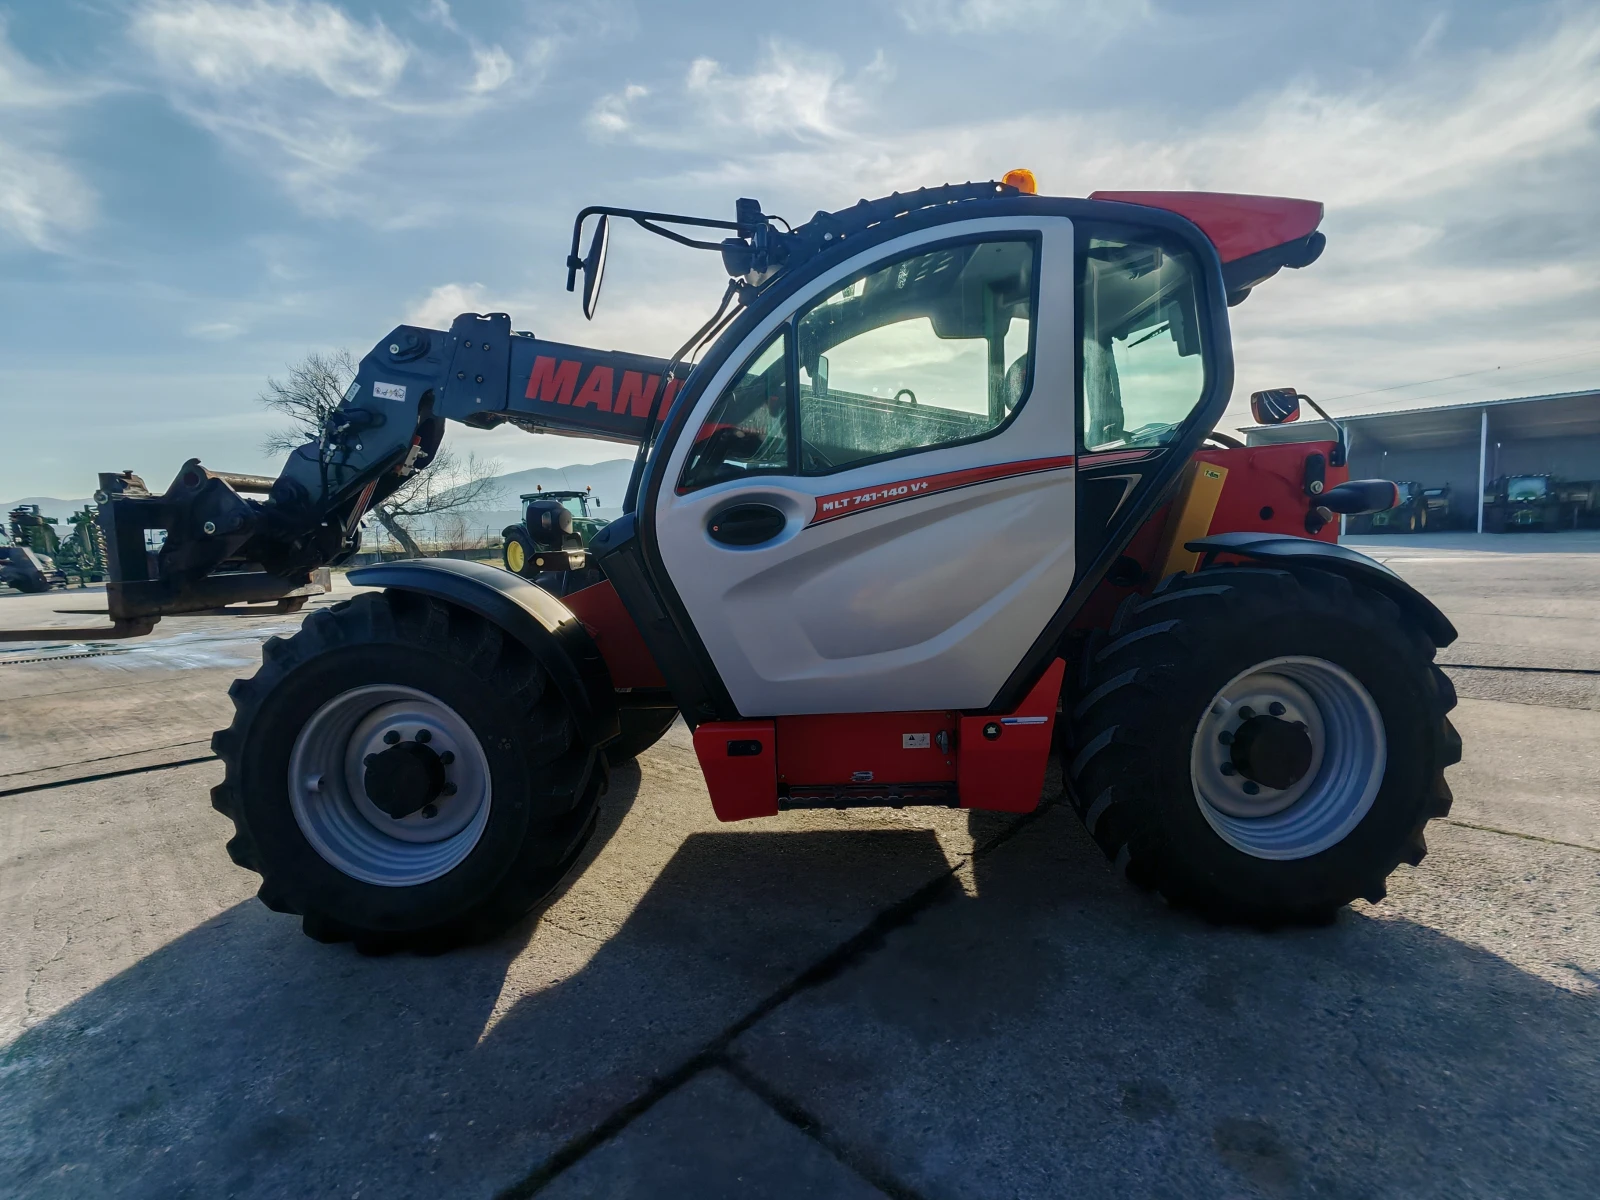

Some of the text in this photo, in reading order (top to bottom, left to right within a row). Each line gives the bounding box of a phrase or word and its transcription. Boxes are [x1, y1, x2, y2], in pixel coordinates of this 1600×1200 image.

[525, 355, 686, 421] MANI
[822, 481, 929, 512] MLT 741-140 V+
